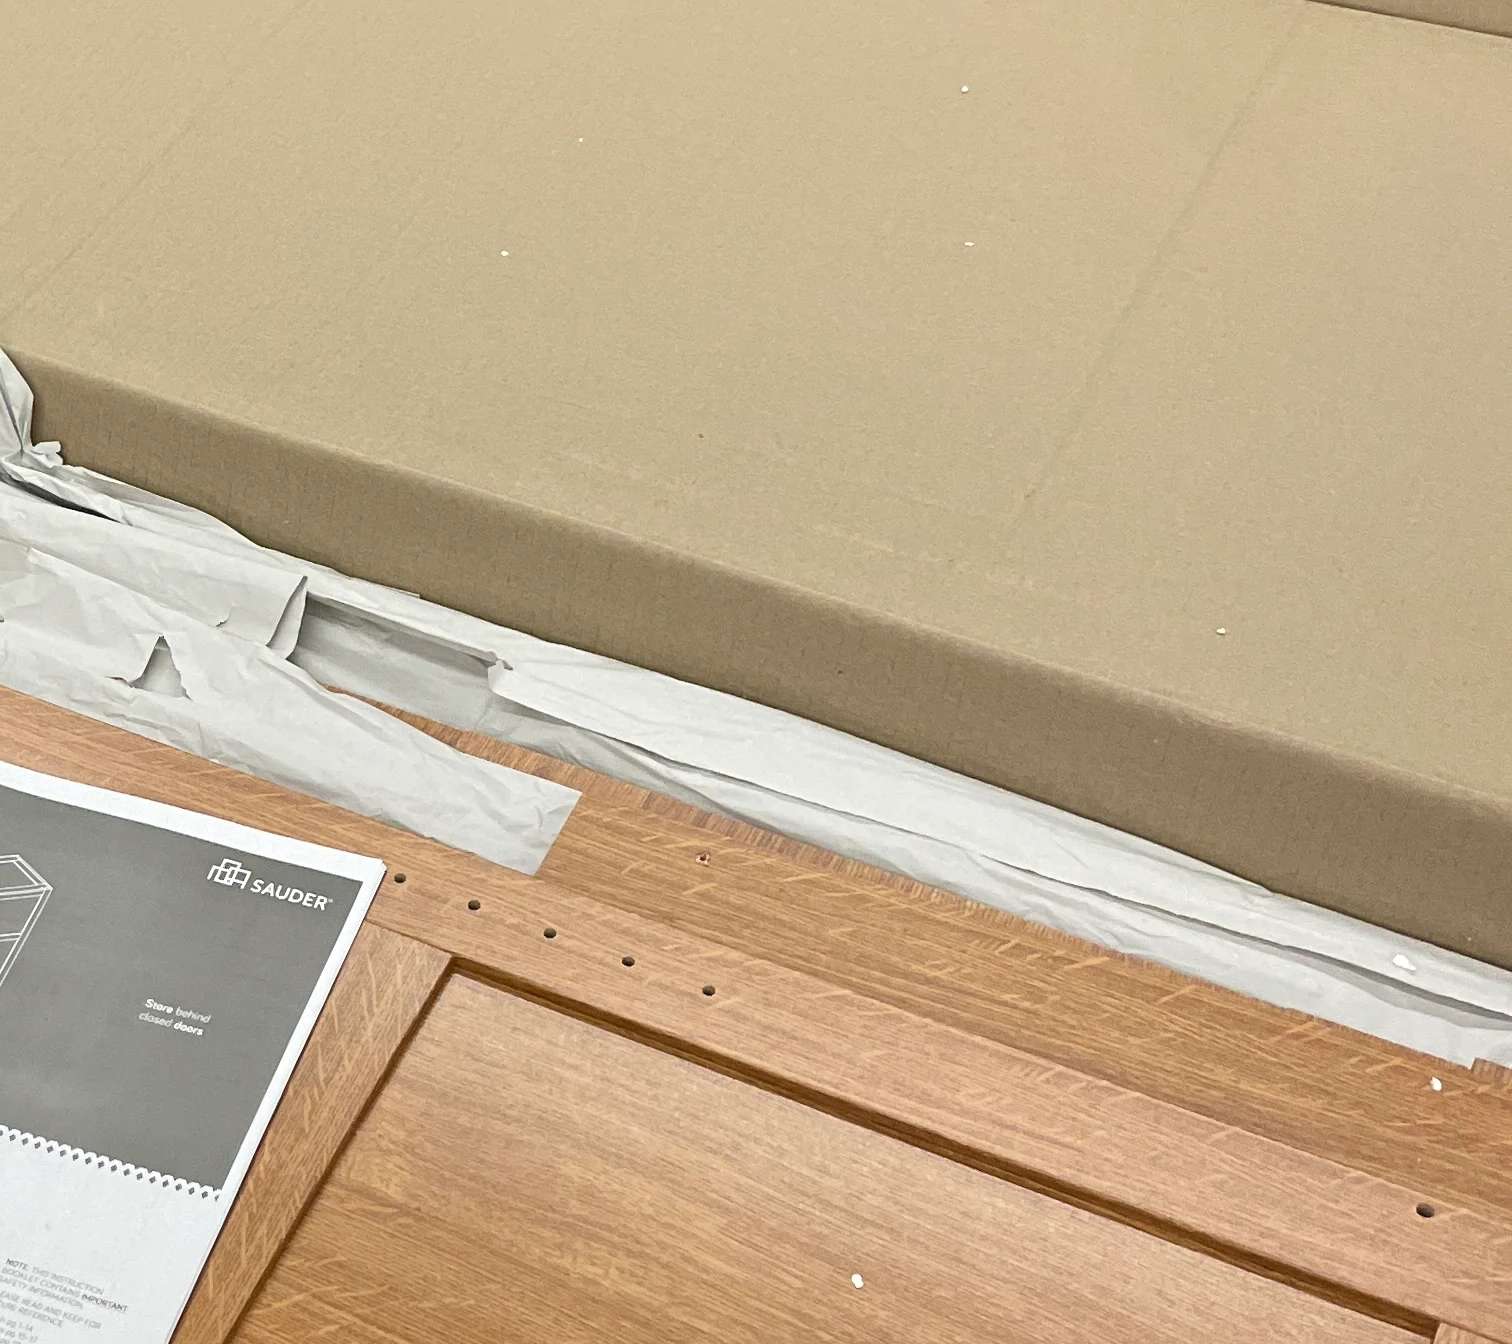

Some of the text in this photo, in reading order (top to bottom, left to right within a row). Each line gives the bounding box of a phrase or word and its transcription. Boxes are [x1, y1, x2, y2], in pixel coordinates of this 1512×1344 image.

[250, 879, 328, 911] SAUDER
[139, 1011, 174, 1028] closed
[145, 998, 212, 1024] Store behind
[81, 1293, 129, 1312] IMPORTANT
